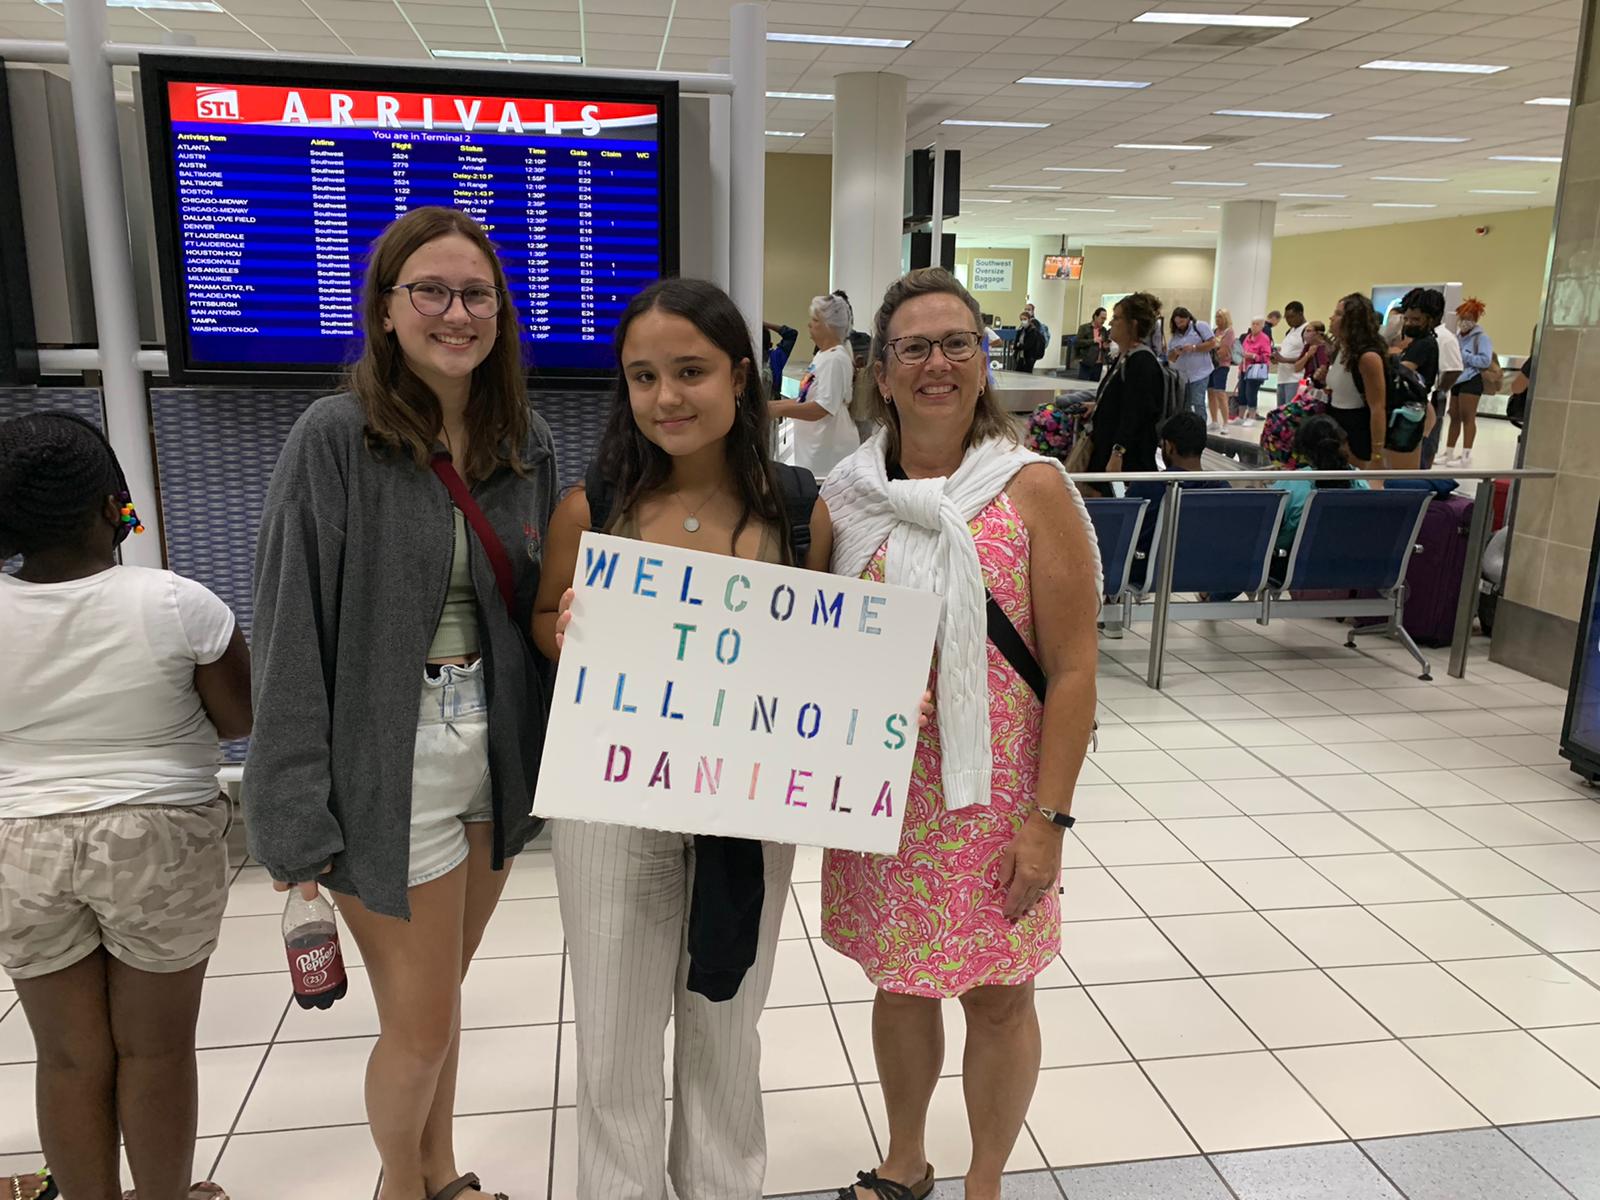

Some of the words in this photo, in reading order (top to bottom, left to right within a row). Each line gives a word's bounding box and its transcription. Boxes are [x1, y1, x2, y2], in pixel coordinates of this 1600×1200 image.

[282, 91, 600, 136] ARRIVALS
[178, 133, 208, 142] Arriving
[372, 130, 391, 140] You
[410, 132, 420, 140] in
[421, 133, 462, 142] Terminal
[177, 143, 210, 151] ATLANTA
[179, 161, 207, 169] AUSTIN
[179, 170, 222, 178] BALTIMORE
[180, 179, 223, 187] BALTIMORE
[182, 197, 248, 205] CHICAGO-MIDWAY
[195, 240, 245, 248] LAUDERDALE
[186, 249, 242, 257] HOUSTON-HOU
[192, 325, 259, 333] WASHINGTON-DCA
[585, 547, 887, 634] WELCOME
[673, 622, 741, 665] TO
[574, 666, 908, 750] ILLINOIS
[604, 744, 893, 817] DANIELA
[309, 946, 325, 962] Dr
[298, 946, 334, 973] Pepper
